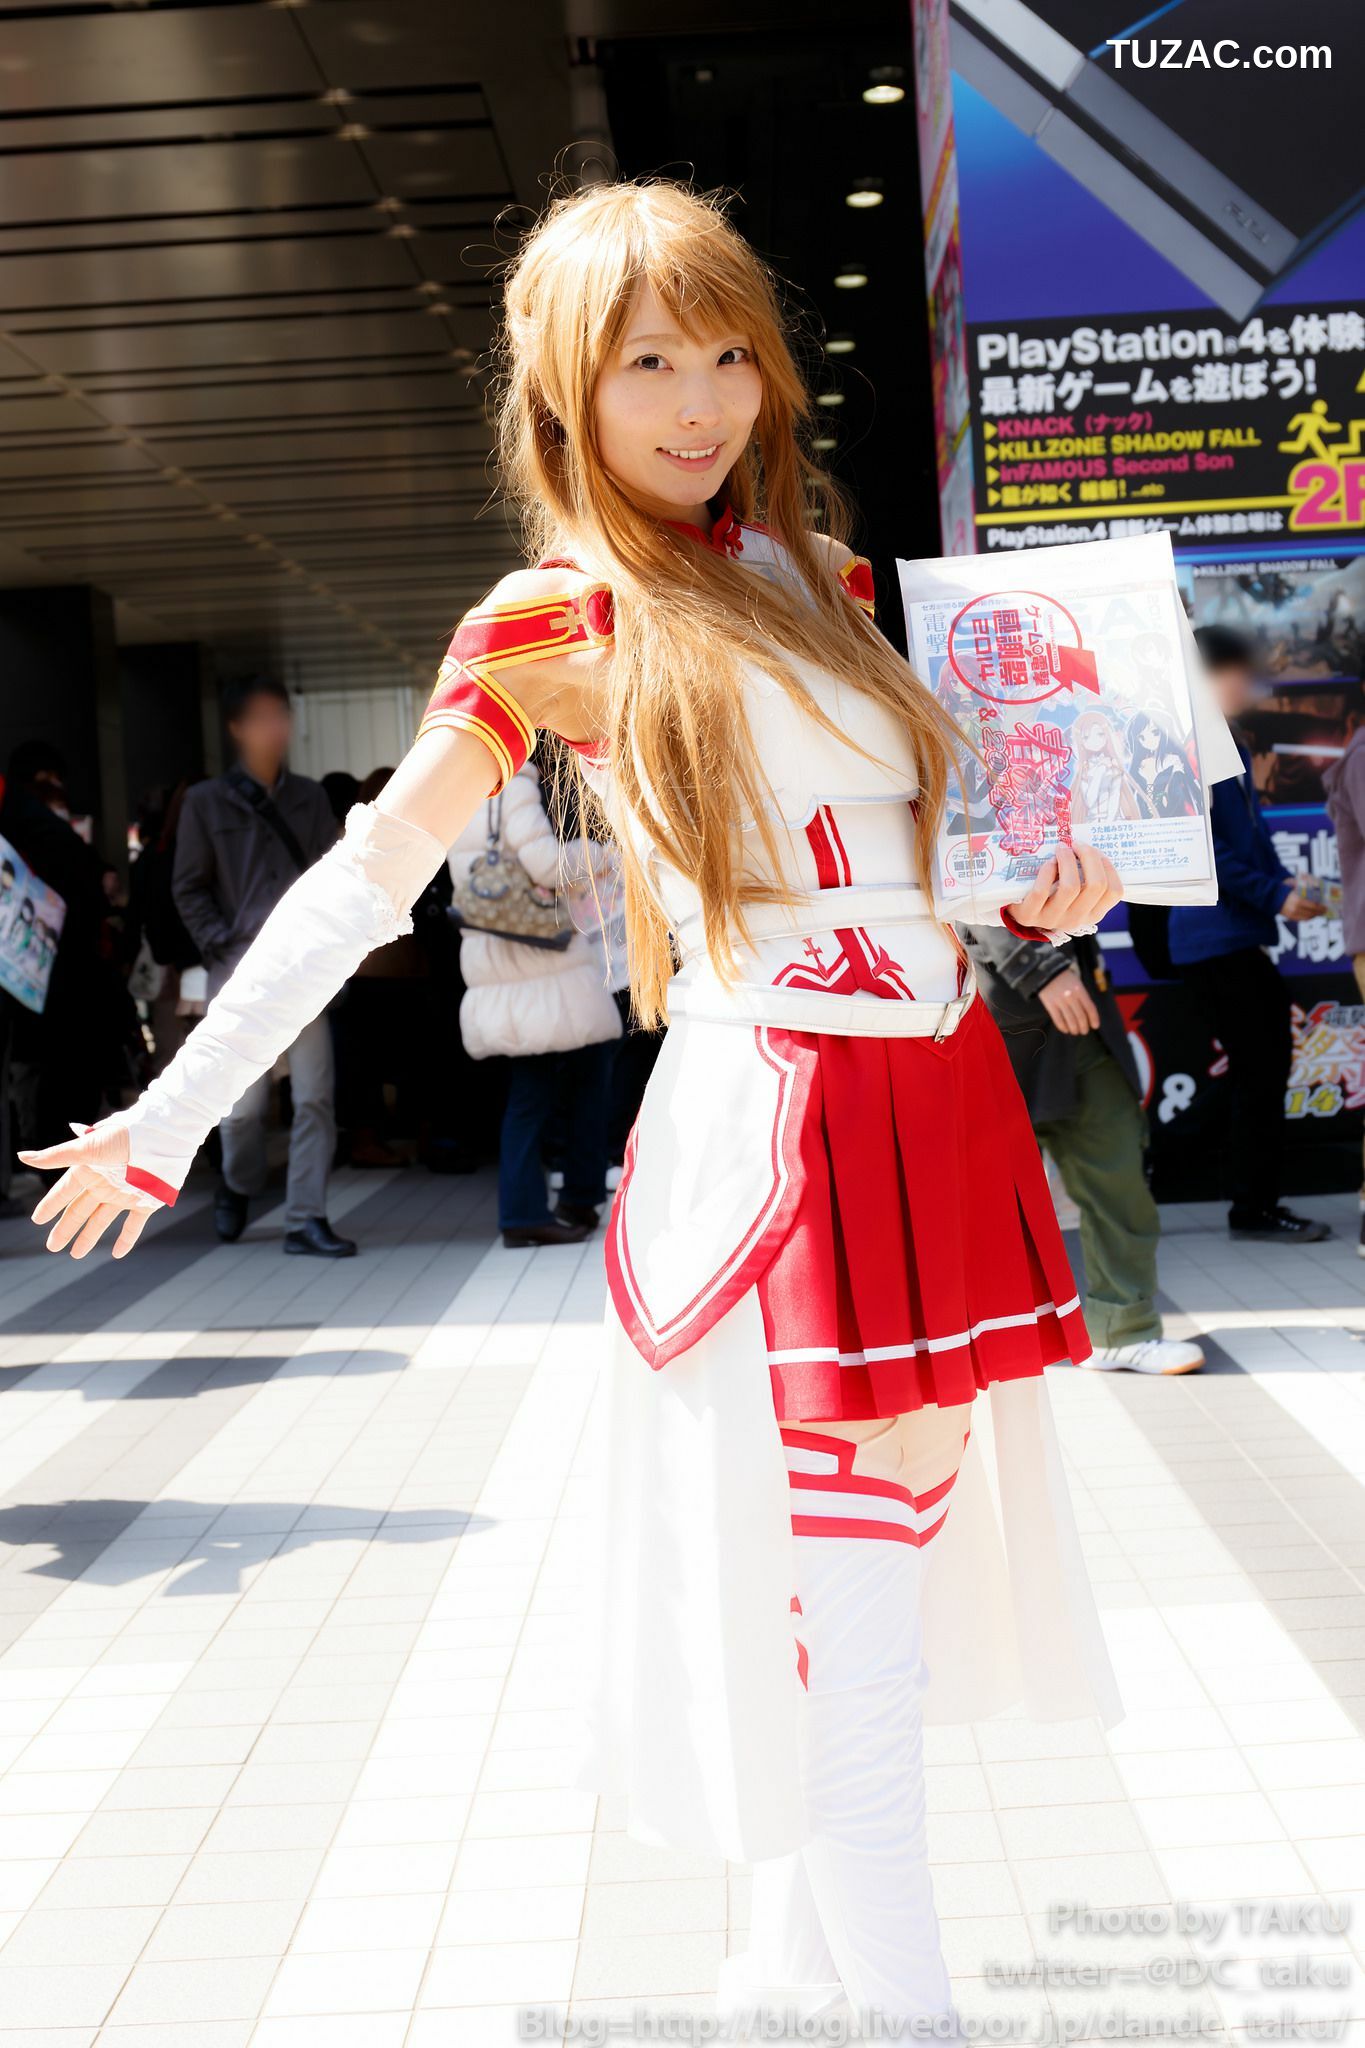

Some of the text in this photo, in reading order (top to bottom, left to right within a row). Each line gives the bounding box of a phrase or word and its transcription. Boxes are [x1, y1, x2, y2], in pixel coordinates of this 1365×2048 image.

[997, 416, 1075, 438] KNACK
[999, 427, 1262, 461] KILLZONE SHADOW FALL
[1001, 452, 1235, 483] inFAMOUS Second Son
[1258, 559, 1308, 573] SHADOW
[1310, 557, 1338, 571] FALL
[923, 613, 948, 655] 電撃
[972, 618, 995, 682] 2014
[992, 609, 1028, 687] 感謝祭
[979, 708, 997, 722] &
[1113, 857, 1190, 869] タシースターオンライン2
[1158, 1073, 1196, 1124] &
